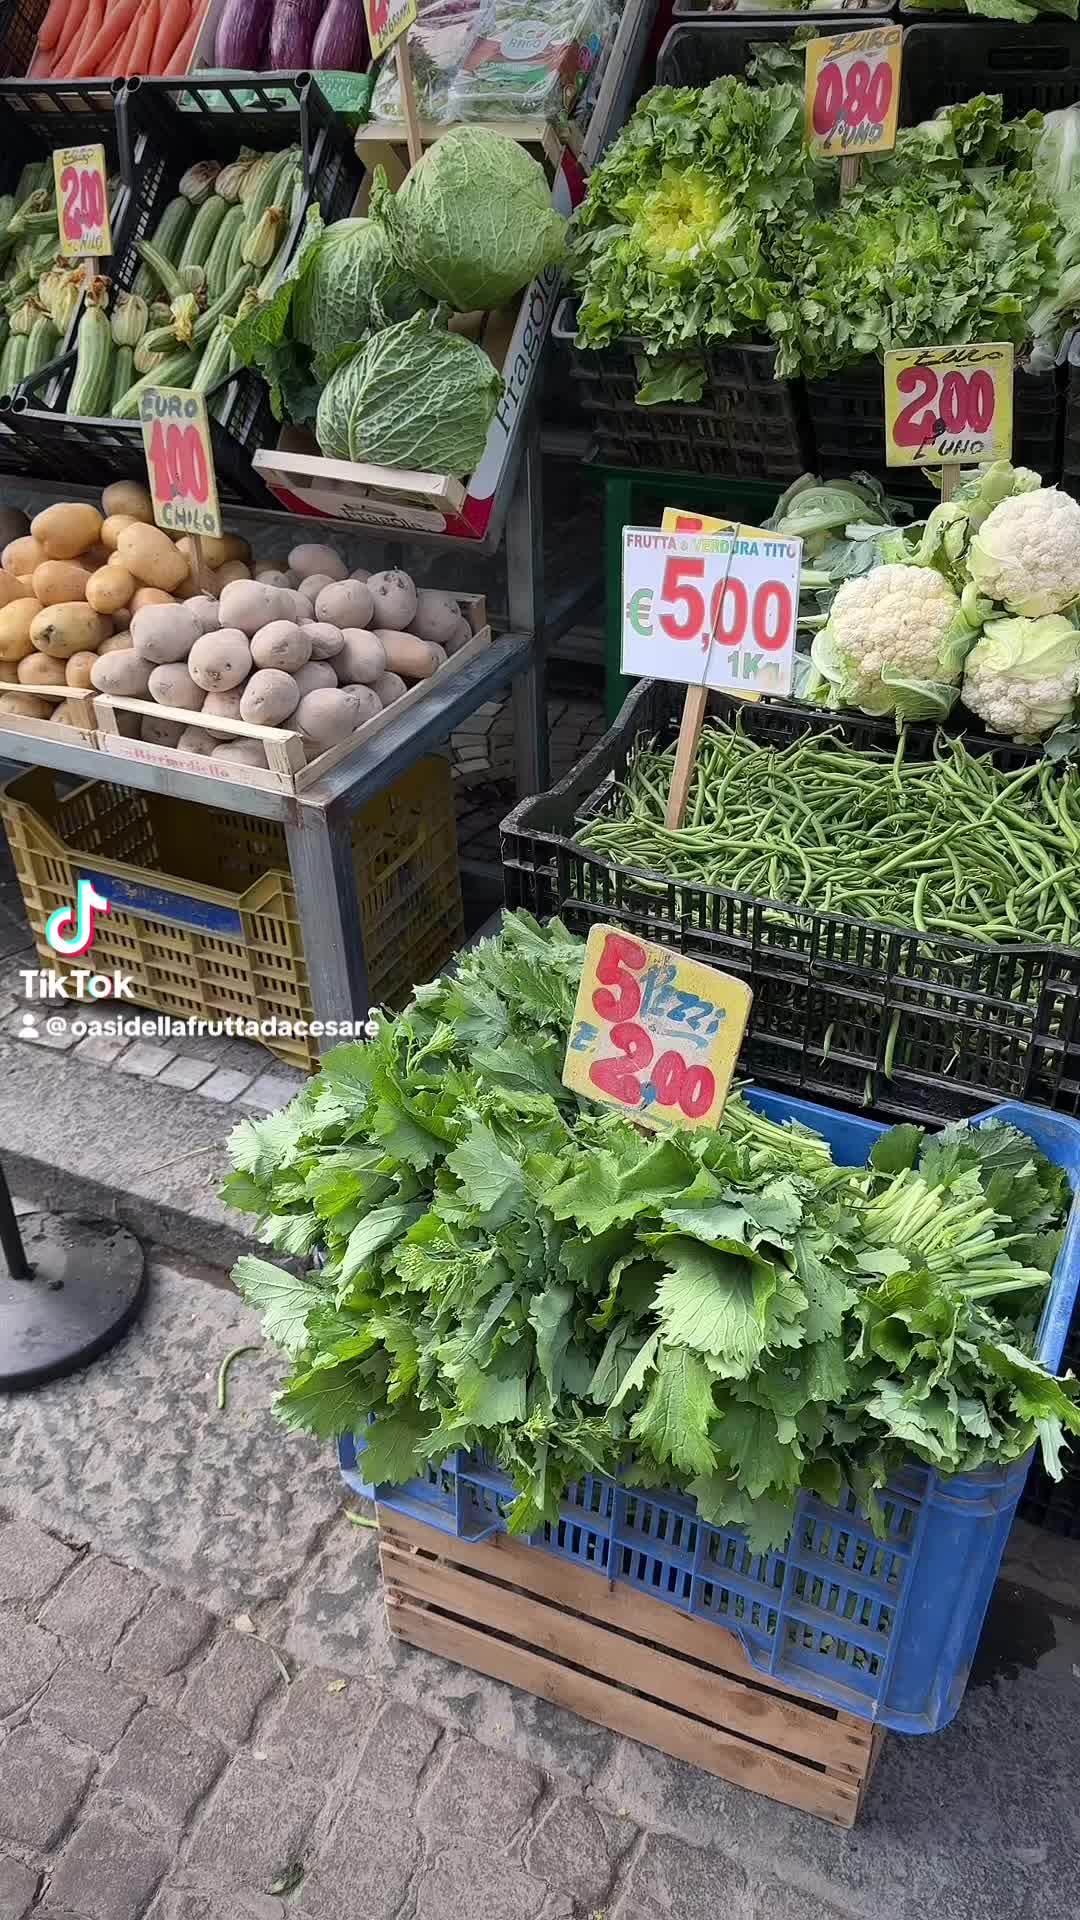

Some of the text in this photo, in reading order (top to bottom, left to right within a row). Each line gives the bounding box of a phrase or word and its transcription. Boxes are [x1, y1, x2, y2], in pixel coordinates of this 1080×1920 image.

[142, 388, 198, 421] EURO
[162, 502, 215, 532] CHILO
[626, 534, 677, 550] FRUTTA
[693, 540, 759, 557] VERDURA
[763, 543, 797, 559] TITO
[592, 933, 647, 1023] 5
